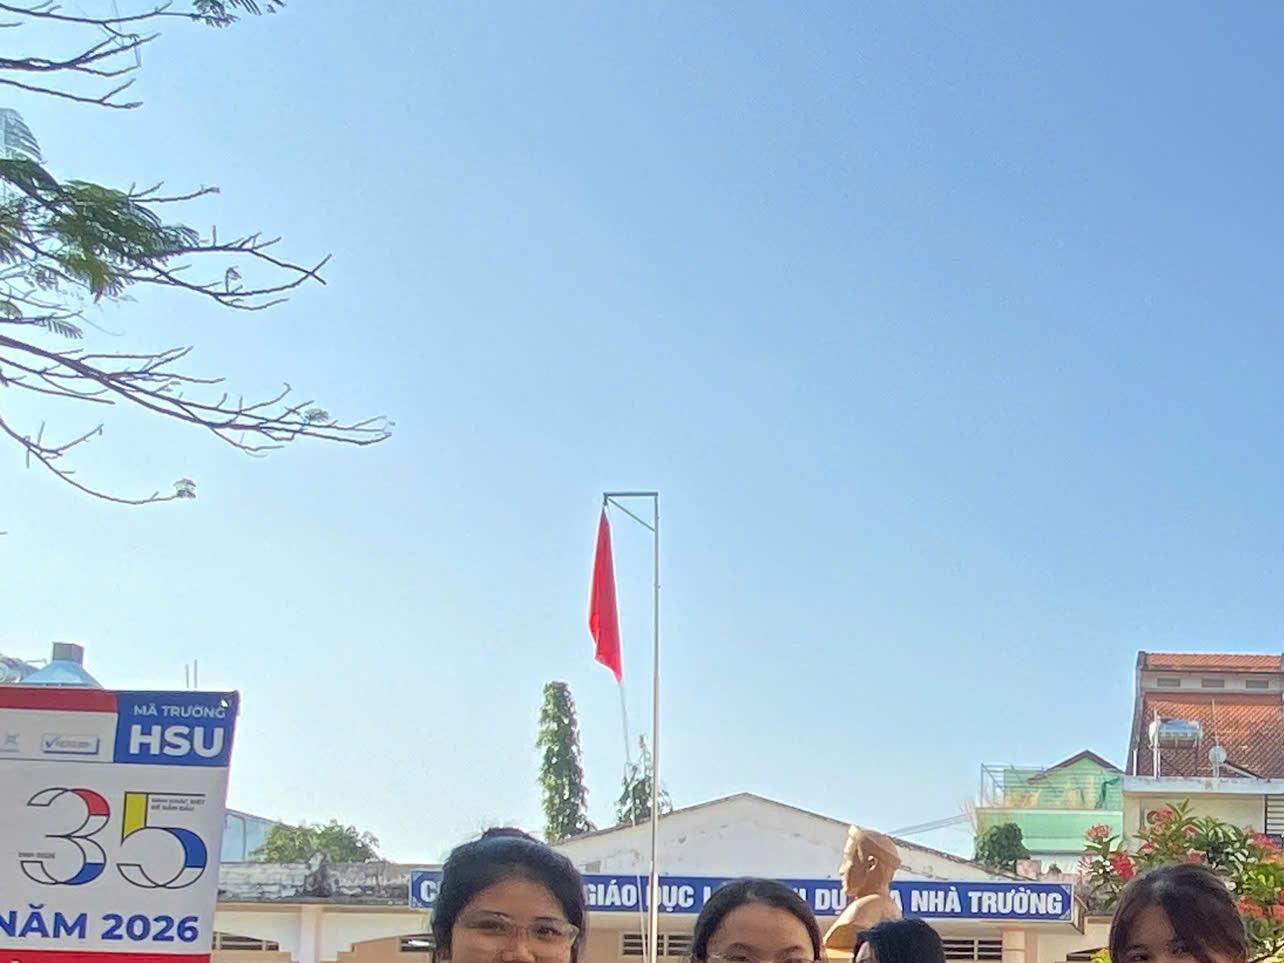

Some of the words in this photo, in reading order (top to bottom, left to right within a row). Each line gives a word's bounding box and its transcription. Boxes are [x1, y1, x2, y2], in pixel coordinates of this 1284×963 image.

[133, 703, 158, 718] MÃ
[162, 703, 227, 719] TRƯỜNG
[128, 724, 224, 758] HSU
[19, 787, 208, 889] 35
[584, 879, 638, 906] GIÁO
[911, 886, 961, 913] NHÀ
[968, 886, 1063, 914] TRƯỜNG
[101, 913, 199, 942] 2026
